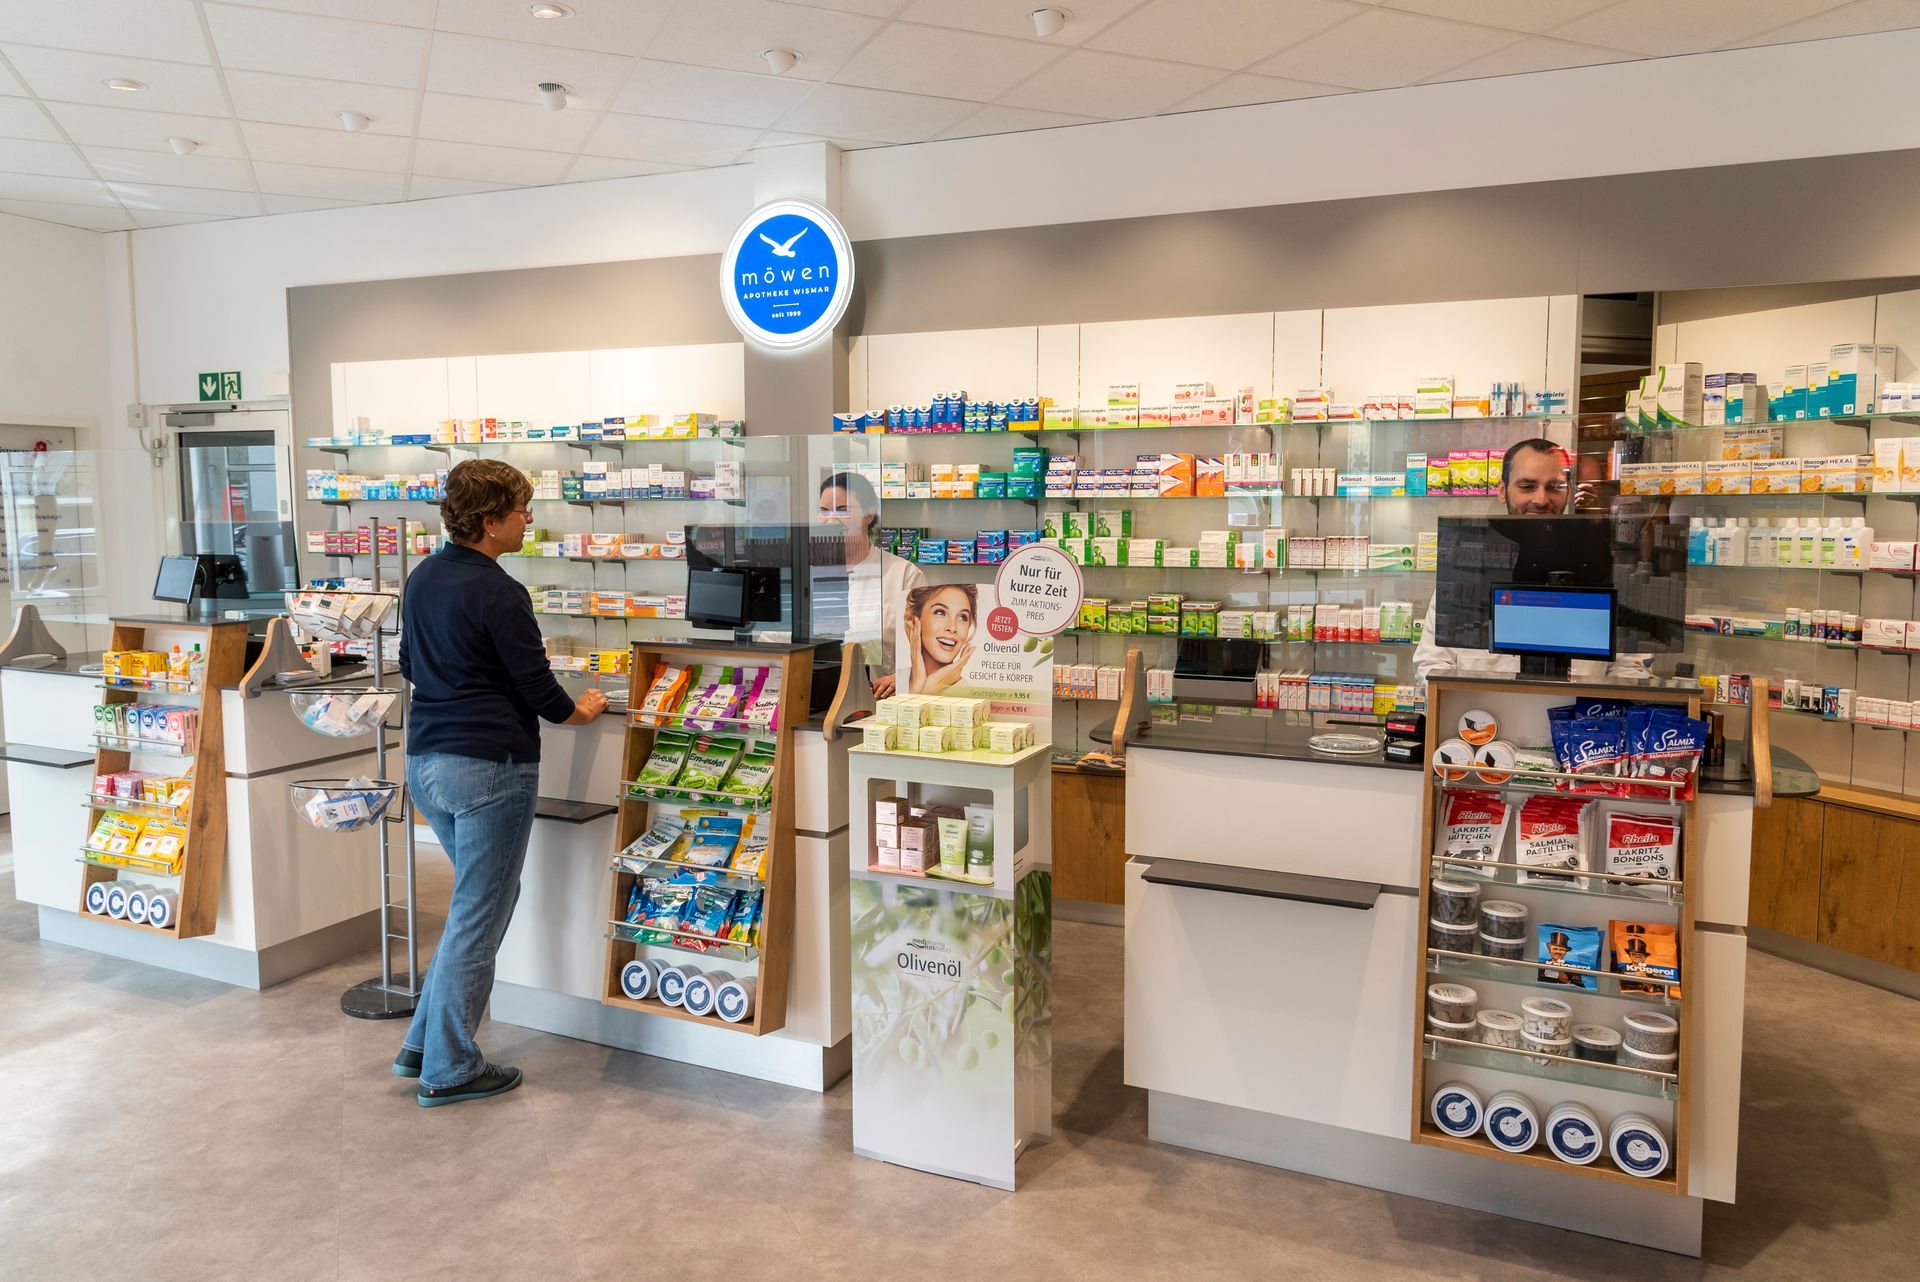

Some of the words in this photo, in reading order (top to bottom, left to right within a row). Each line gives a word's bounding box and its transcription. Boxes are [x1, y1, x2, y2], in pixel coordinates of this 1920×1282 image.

[742, 264, 830, 286] möwen
[743, 289, 789, 300] APOTHEKE
[793, 286, 830, 296] WISMAR
[771, 312, 785, 320] seit
[786, 310, 802, 318] 1999
[1535, 391, 1565, 400] Septolete
[1829, 457, 1854, 465] HEXAL
[1019, 564, 1041, 579] Nur
[1045, 566, 1062, 581] für
[1010, 578, 1042, 596] kurze
[1045, 584, 1068, 601] Zeit
[1011, 597, 1028, 608] ZUM
[1029, 599, 1063, 614] AKTIONS-
[993, 615, 1011, 625] JETZT
[1026, 611, 1046, 621] PREIS
[991, 624, 1014, 634] TESTEN
[983, 642, 1020, 655] Olivenöl
[981, 661, 1006, 670] PFLEGE
[969, 671, 998, 681] GESICHT
[999, 673, 1005, 682] &
[1014, 692, 1026, 700] 9,95
[1654, 729, 1695, 752] SALMIX
[1574, 740, 1615, 763] SALMIX
[689, 752, 727, 769] Em-eukal
[738, 762, 771, 778] Em-eukal
[1457, 810, 1493, 820] Rheila
[116, 820, 137, 832] Ricola
[1451, 826, 1490, 835] LAKRITZ
[1447, 832, 1492, 842] HÜTCHEN
[1621, 834, 1660, 844] Rheila
[1525, 843, 1575, 857] PASTILLEN
[1617, 847, 1661, 856] LAKRITZ
[1613, 854, 1664, 864] BONBONS
[912, 938, 946, 947] medipharma
[897, 952, 962, 979] Olivenöl
[1626, 962, 1675, 977] Krügerol
